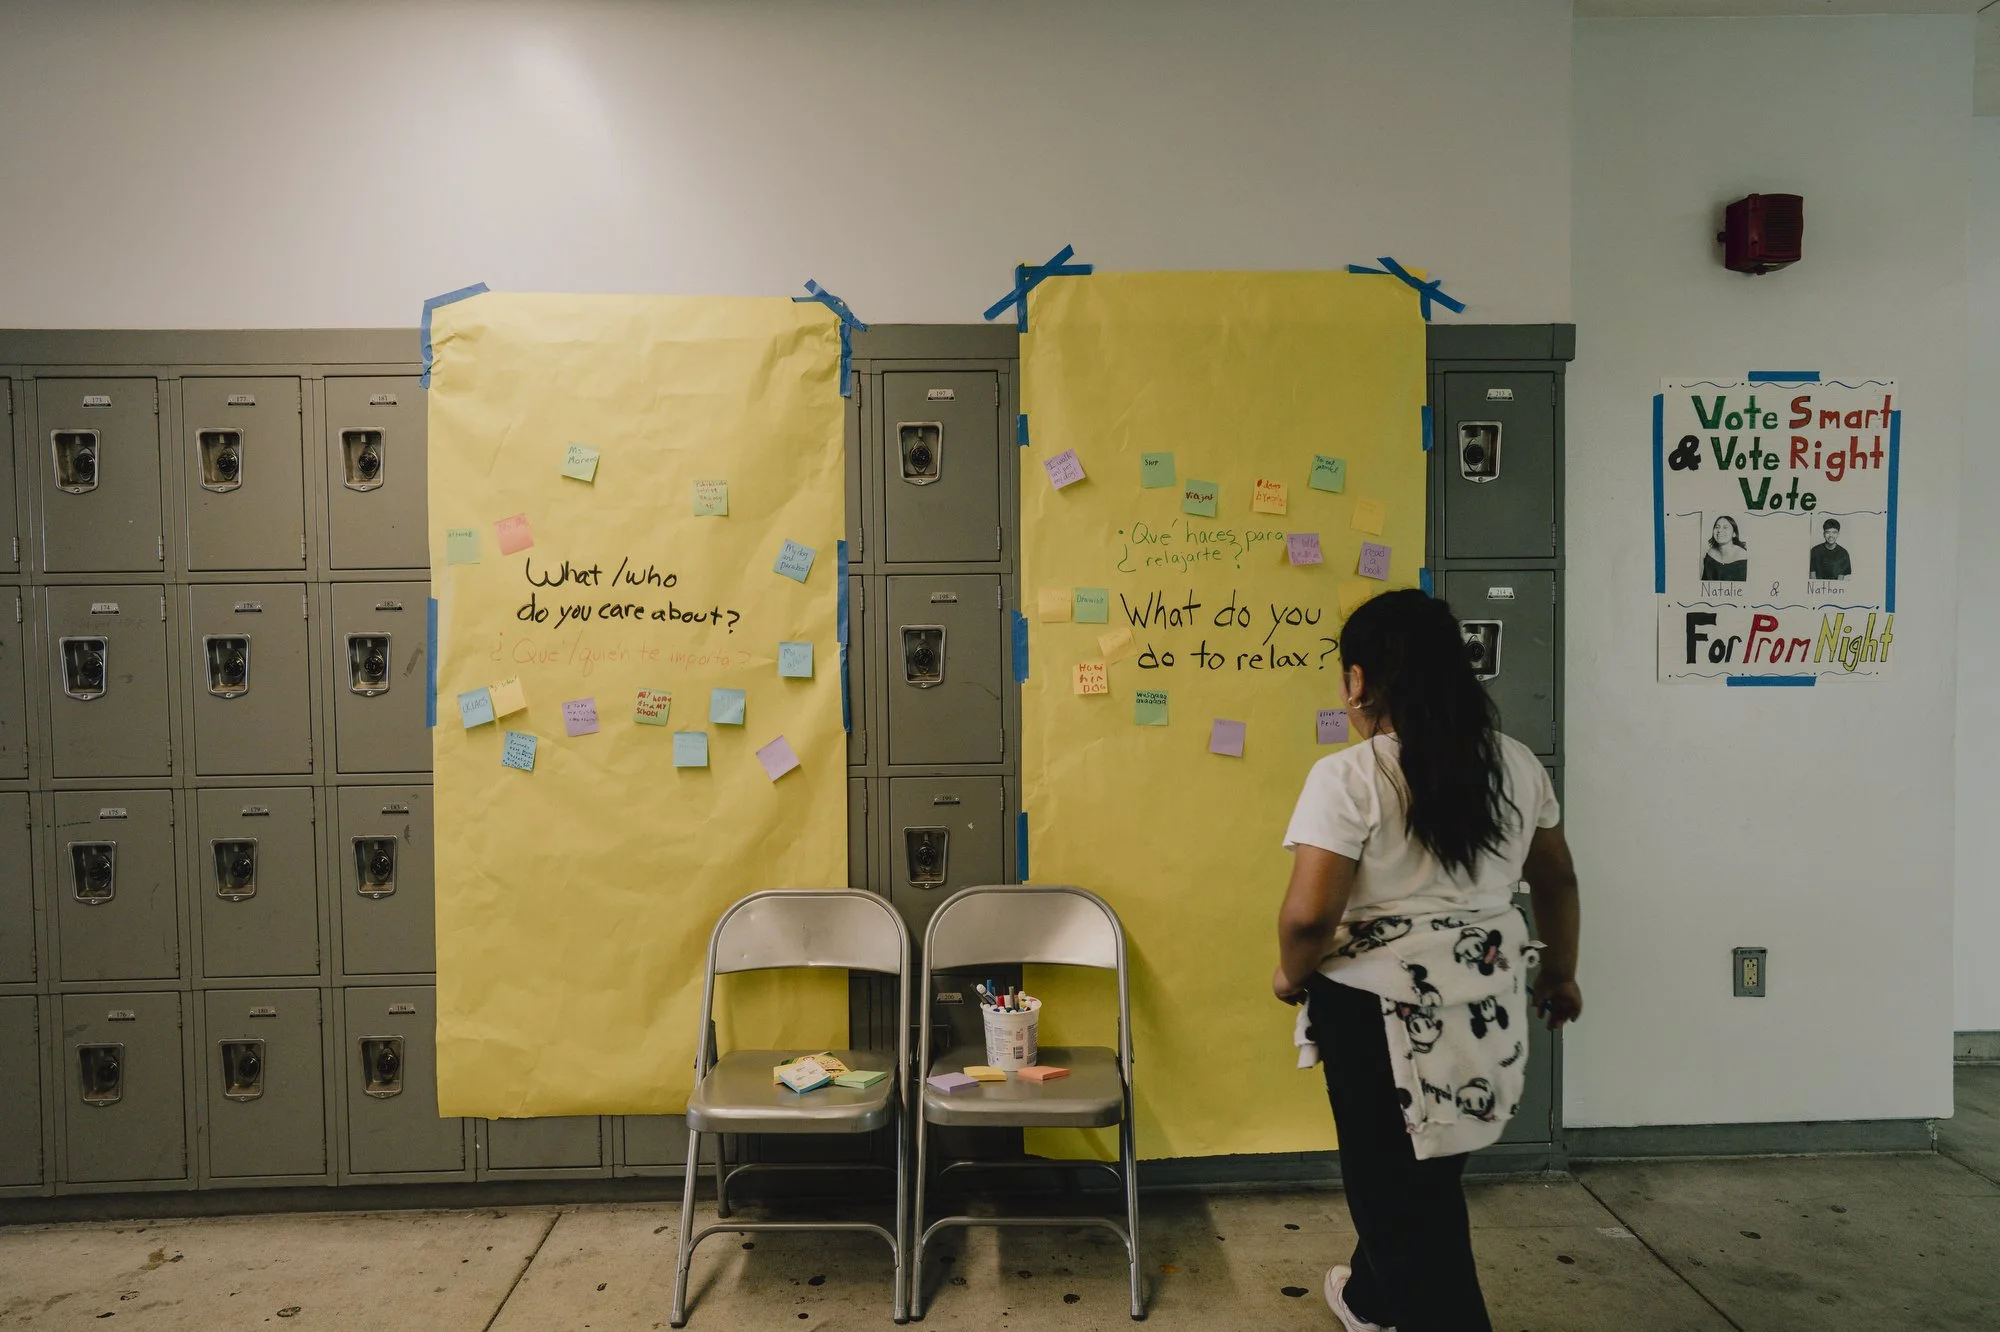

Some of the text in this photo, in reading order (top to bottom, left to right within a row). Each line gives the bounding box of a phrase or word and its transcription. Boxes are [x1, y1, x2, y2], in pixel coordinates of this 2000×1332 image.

[1691, 394, 1893, 429] Vote Smart
[1668, 434, 1884, 482] & Vote Right
[1738, 476, 1817, 511] Vote
[1186, 520, 1236, 544] haces
[1245, 529, 1285, 552] para
[525, 557, 602, 587] What
[1701, 582, 1743, 598] Natalie
[1806, 581, 1845, 595] Nathan
[517, 592, 740, 634] do you care about?
[1120, 589, 1321, 646] What do you
[638, 643, 660, 660] te
[1137, 643, 1175, 670] do
[1190, 640, 1225, 670] to
[1685, 612, 1893, 672] For Prom Night
